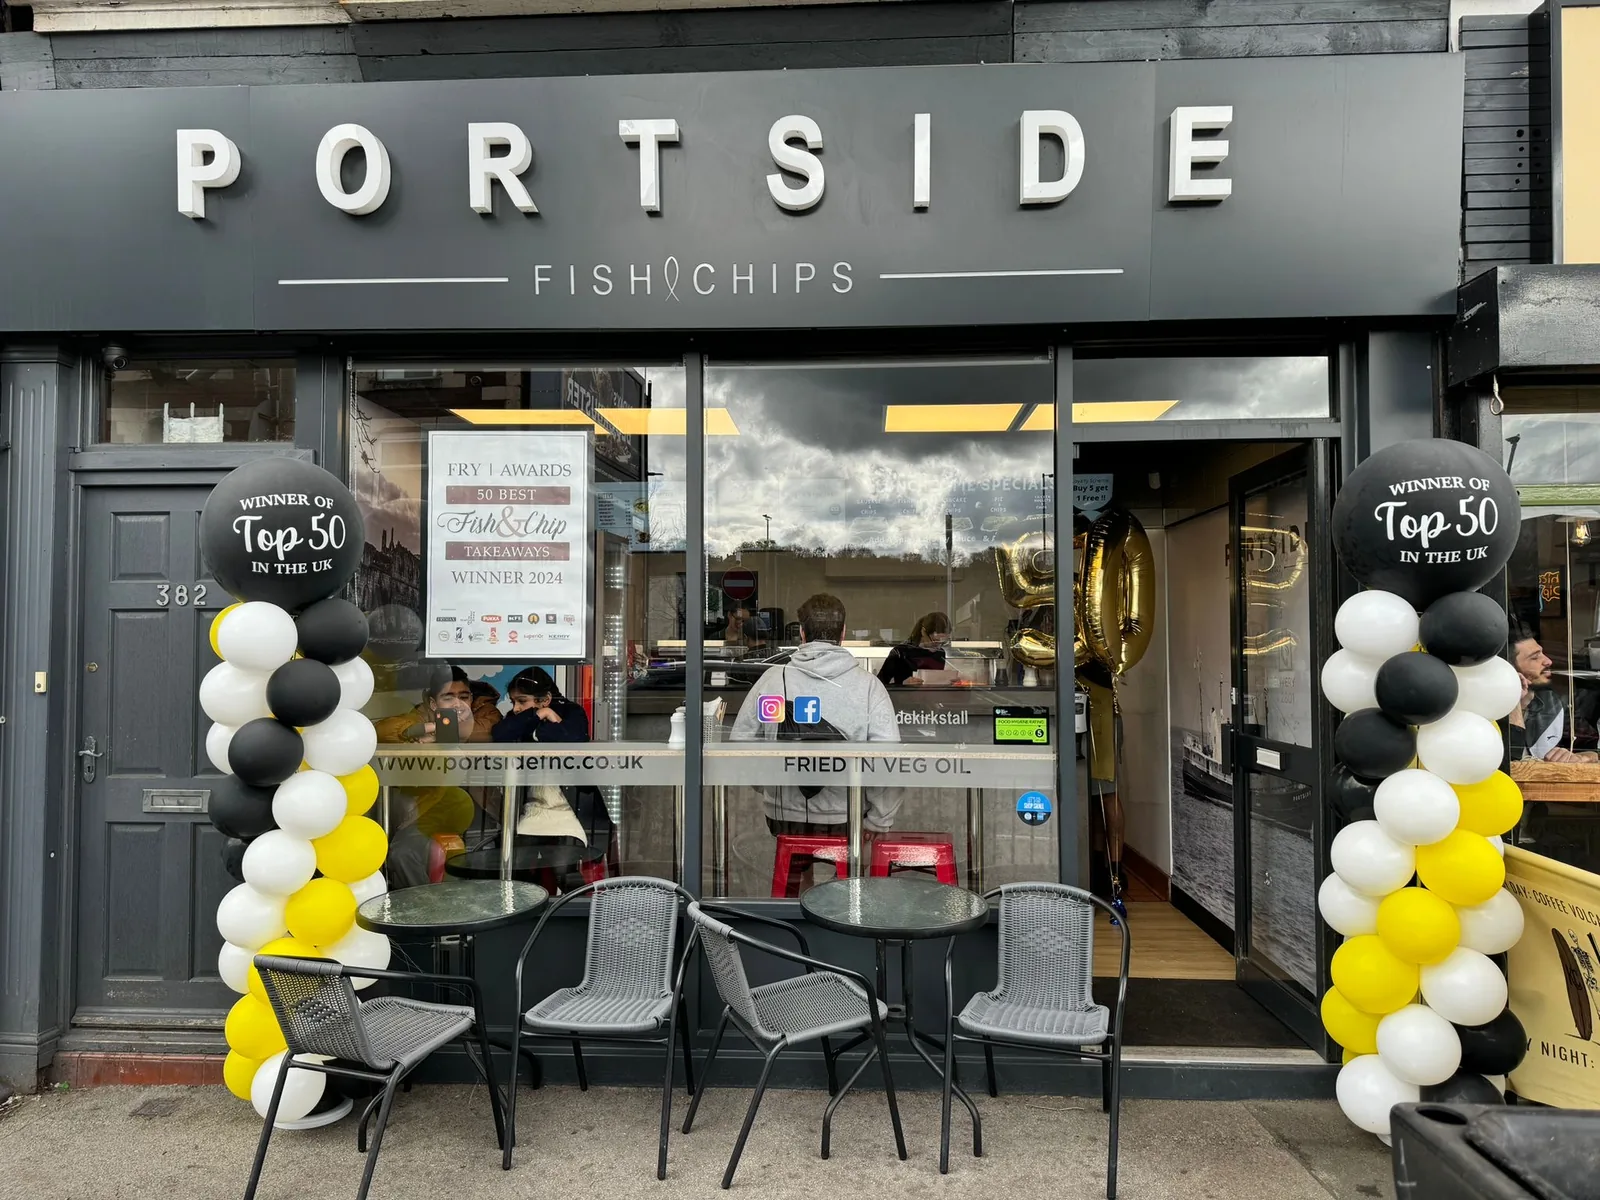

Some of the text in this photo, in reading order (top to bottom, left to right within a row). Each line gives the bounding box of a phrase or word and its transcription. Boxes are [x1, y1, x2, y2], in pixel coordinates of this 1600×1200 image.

[176, 105, 1233, 218] PORTSIDE
[534, 261, 854, 295] FISH CHIPS
[447, 463, 572, 477] FRY AWARDS
[476, 488, 537, 500] 50 BEST
[1073, 485, 1088, 493] Buy
[1095, 485, 1109, 493] get
[1388, 476, 1490, 496] WINNER OF
[239, 494, 334, 510] WINNER OF
[1374, 495, 1498, 548] Top 50
[232, 513, 346, 560] Top 50
[463, 546, 550, 557] TAKEAWAYS
[1400, 546, 1489, 563] IN THE UK
[251, 559, 333, 574] IN THE UK
[451, 571, 563, 584] WINNER 2024
[156, 584, 207, 606] 382
[784, 757, 971, 774] FRIED IN VEG OIL
[1508, 881, 1532, 899] DAY:
[1532, 889, 1569, 915] COFFEE
[1541, 1040, 1595, 1069] NIGHT:
